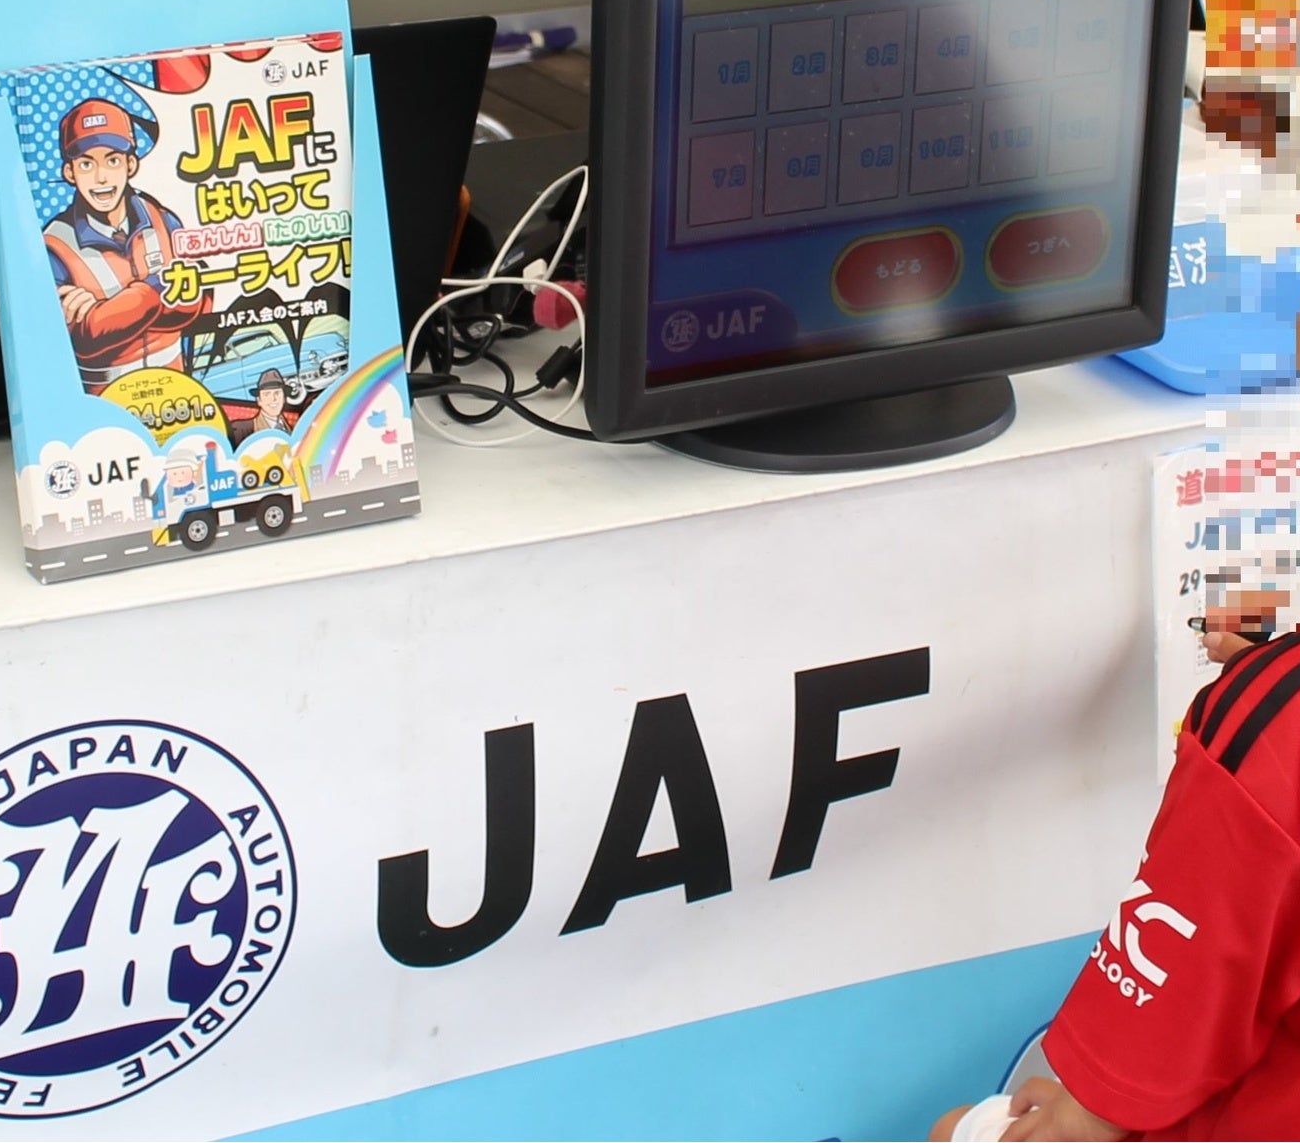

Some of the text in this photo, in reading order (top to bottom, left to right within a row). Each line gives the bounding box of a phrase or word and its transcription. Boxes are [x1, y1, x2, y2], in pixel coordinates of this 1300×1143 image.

[292, 59, 330, 79] JAF
[719, 61, 751, 83] 1月
[792, 53, 826, 76] 2月
[938, 35, 971, 57] 4月
[713, 164, 747, 187] 7月
[861, 145, 894, 168] 9月
[919, 135, 964, 159] 10月
[196, 170, 330, 223] はいって
[875, 235, 1071, 279] もどる つぎへ
[217, 300, 328, 327] JAF入会のご案内
[706, 305, 766, 339] JAF
[88, 456, 140, 486] JAF
[210, 477, 235, 491] JAF
[378, 646, 930, 968] JAF
[116, 804, 283, 1087] AUTOMOBILE
